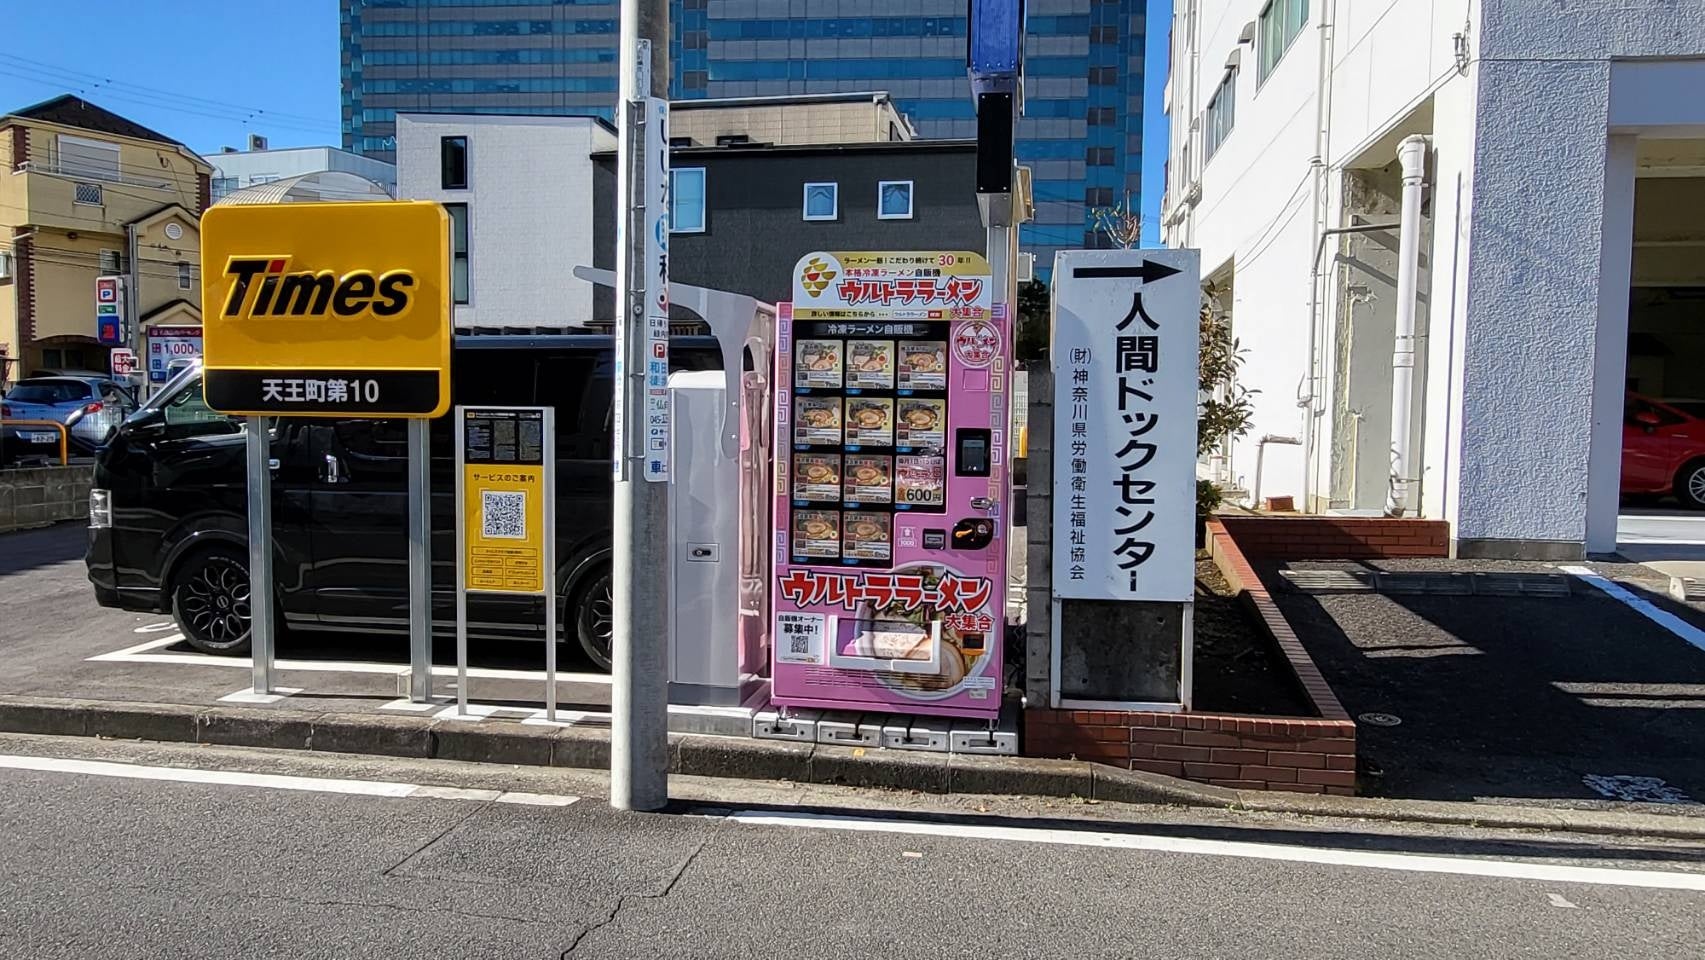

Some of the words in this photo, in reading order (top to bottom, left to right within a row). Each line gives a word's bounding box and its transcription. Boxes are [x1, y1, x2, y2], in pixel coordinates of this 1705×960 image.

[938, 255, 955, 266] 30
[845, 269, 941, 278] 本格冷凍ラーメン自販機
[102, 290, 111, 298] P
[224, 258, 414, 318] Times
[838, 277, 982, 305] ウルトララーメン
[951, 306, 984, 319] 大集合
[827, 324, 914, 335] 冷凍ラーメン自販機
[656, 344, 664, 358] P
[262, 379, 379, 403] 天王町第10
[1112, 292, 1161, 592] 人間ドックセンター
[1069, 347, 1092, 581] (財)神奈川県労働衛生福祉協会
[473, 473, 535, 483] サービスのご案内
[778, 568, 992, 612] ウルトララーメン
[945, 614, 994, 633] 大集合
